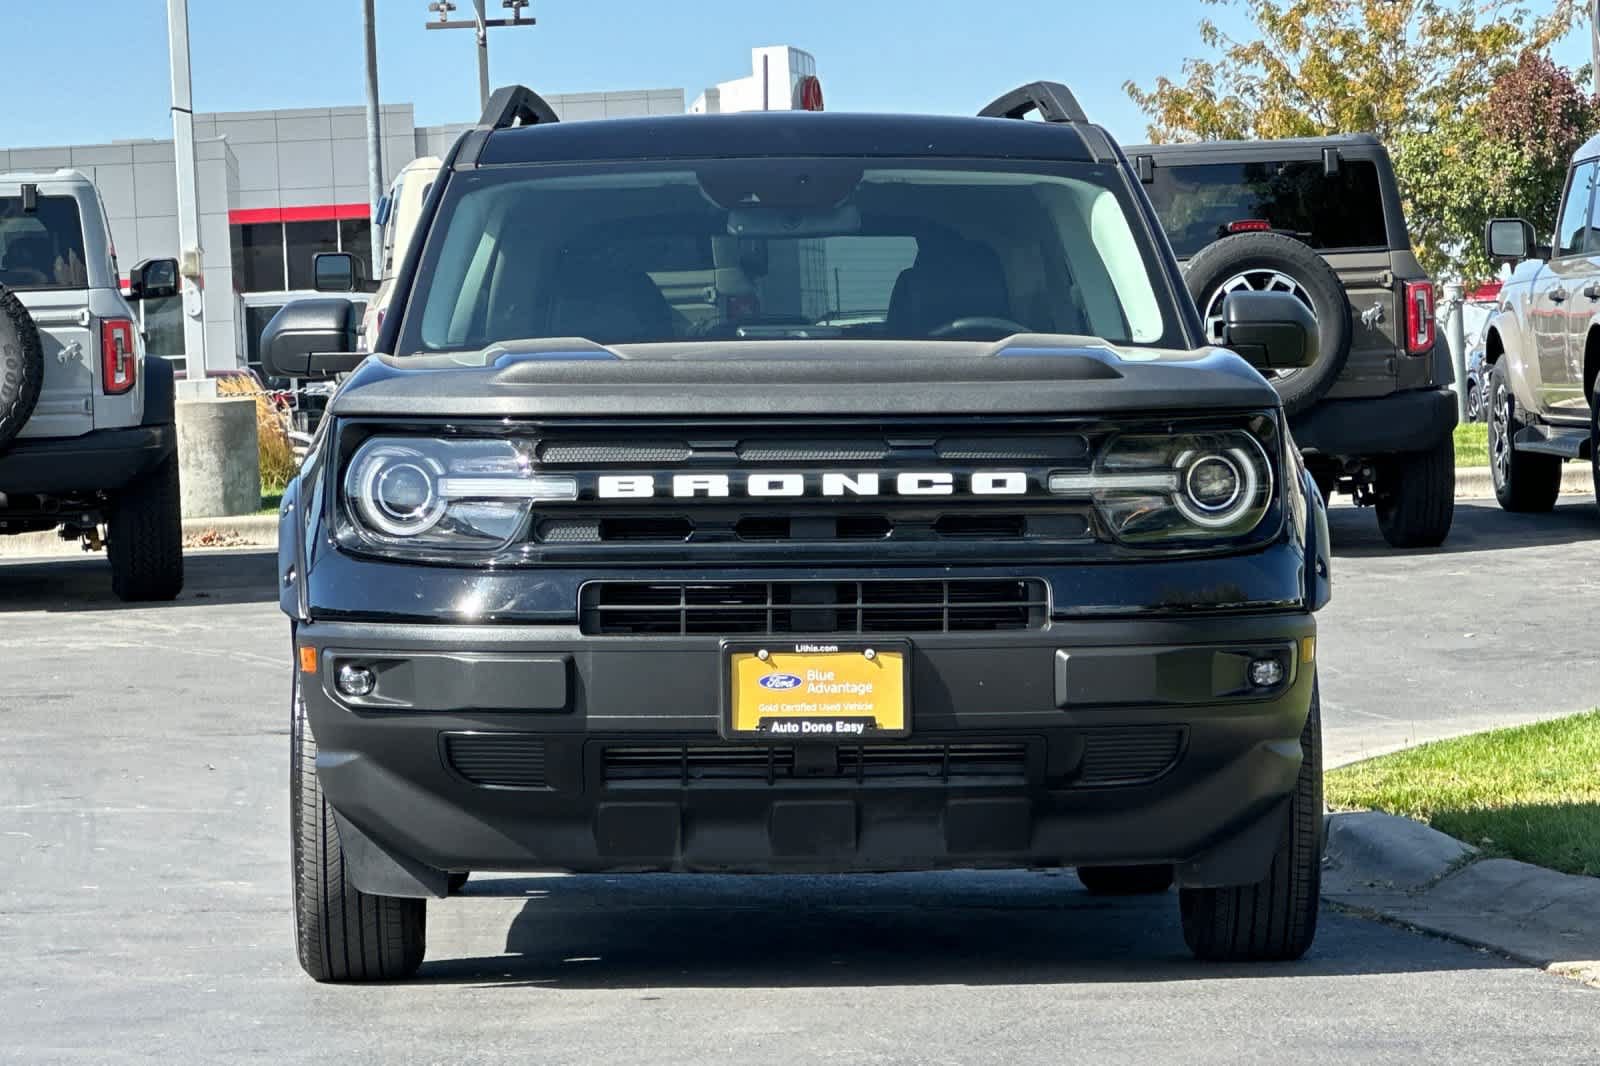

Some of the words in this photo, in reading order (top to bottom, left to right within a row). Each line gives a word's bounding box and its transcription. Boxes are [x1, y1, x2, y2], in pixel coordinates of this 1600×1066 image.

[598, 472, 1027, 498] BRONCO
[795, 644, 838, 653] Lithia.com
[765, 675, 795, 688] Ford
[807, 669, 834, 681] Blue
[807, 681, 873, 695] Advantage
[758, 703, 778, 712] Gold
[780, 703, 817, 712] Certified
[819, 703, 841, 712] Used
[843, 703, 874, 712] Vehicle
[771, 722, 799, 733] Auto
[801, 722, 833, 733] Done
[835, 721, 864, 734] Easy
